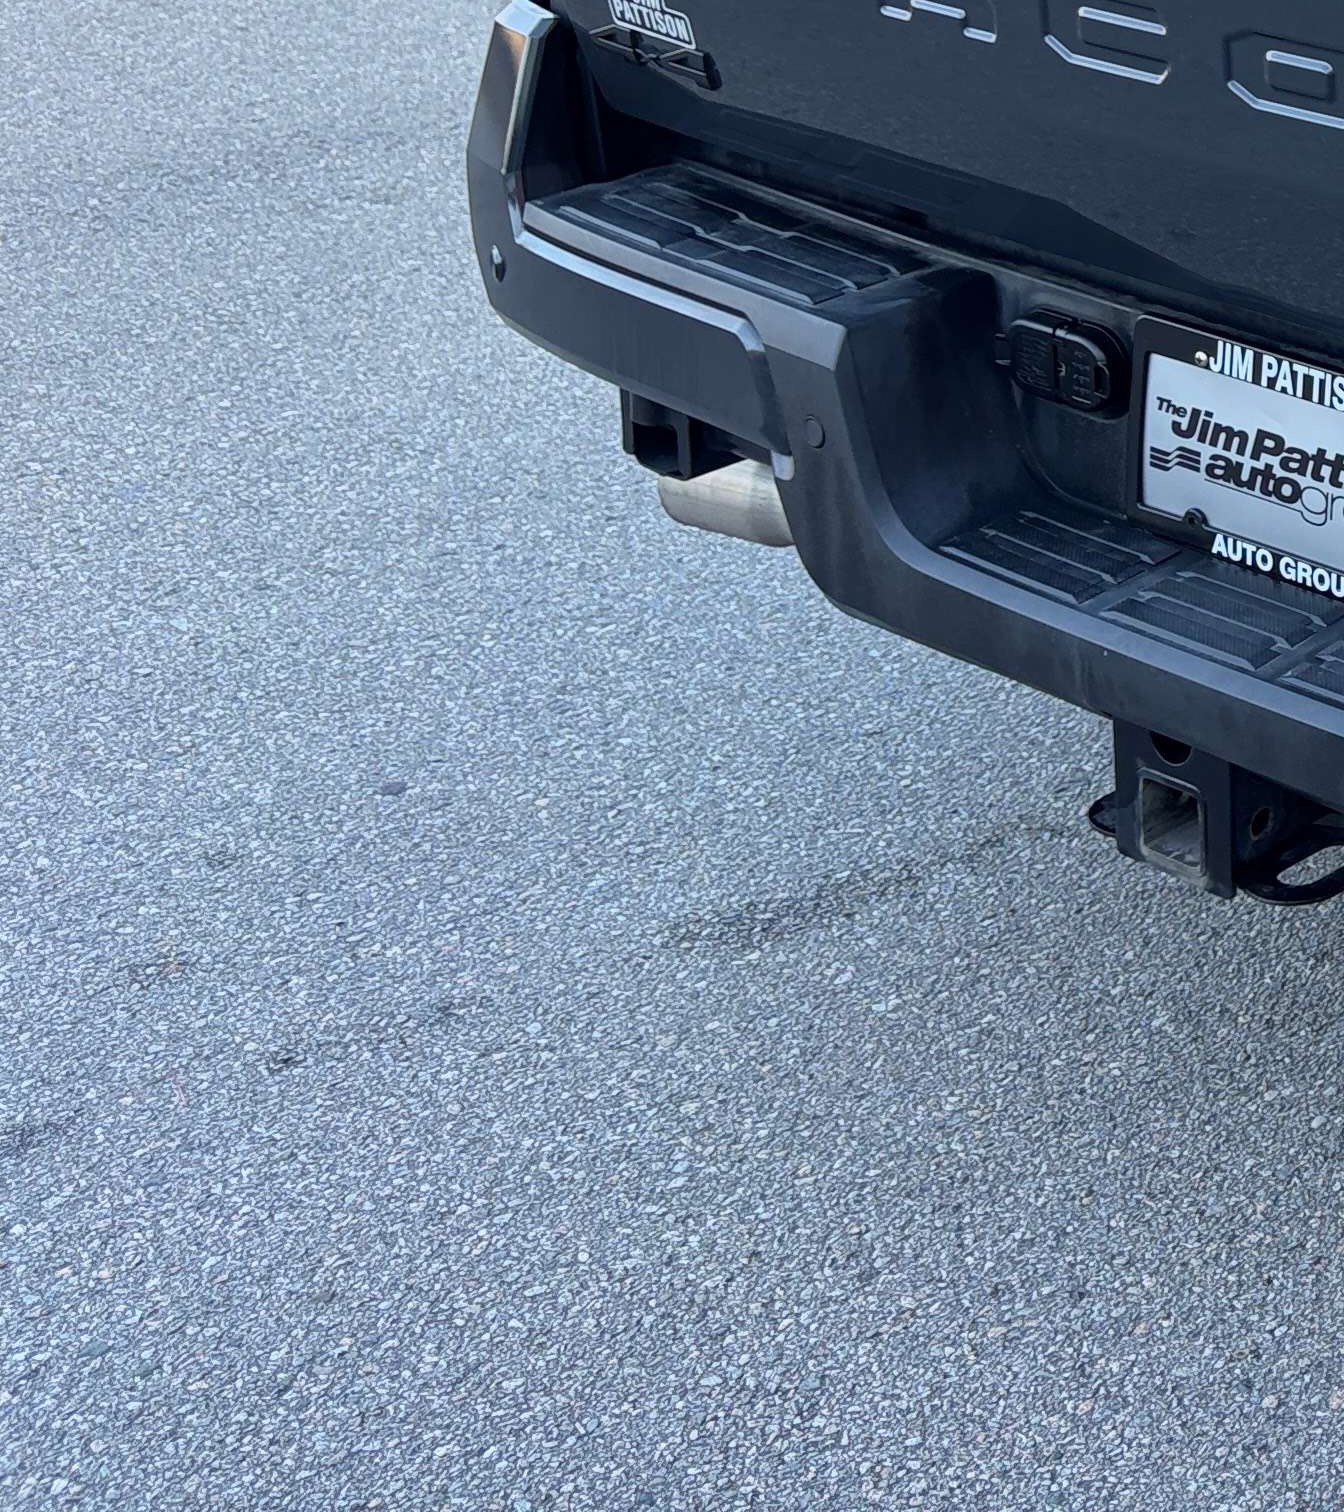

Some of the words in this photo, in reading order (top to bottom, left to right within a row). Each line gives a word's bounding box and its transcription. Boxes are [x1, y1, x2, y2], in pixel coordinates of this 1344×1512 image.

[1209, 340, 1254, 382] JIM
[1156, 396, 1188, 418] The
[1211, 533, 1274, 573] AUTO
